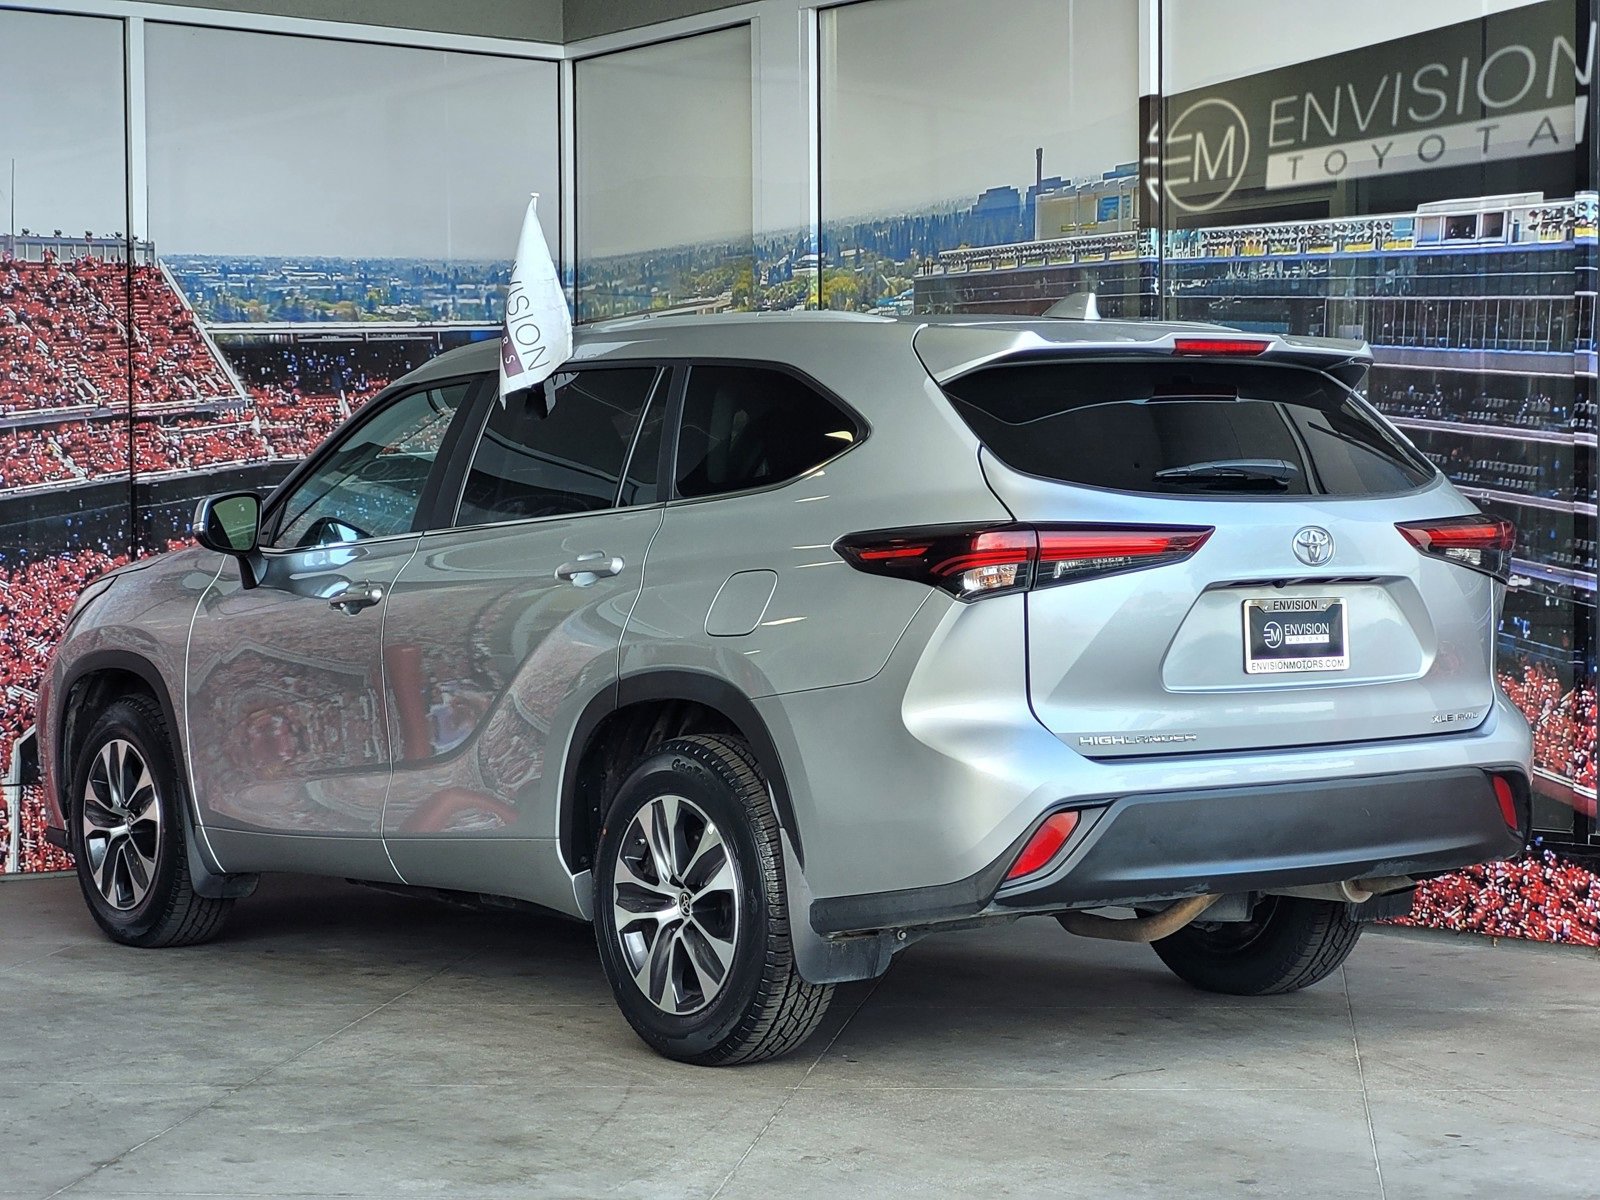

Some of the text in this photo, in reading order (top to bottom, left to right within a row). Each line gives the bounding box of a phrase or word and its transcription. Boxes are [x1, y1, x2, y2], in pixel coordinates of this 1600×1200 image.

[1268, 21, 1597, 147] ENVISION
[1287, 116, 1559, 180] TOYOTA
[1273, 600, 1318, 611] ENVISION
[1284, 622, 1330, 635] ENVISION
[1251, 659, 1345, 671] ENVISIONMOTORS.COM
[1432, 714, 1454, 724] XLE
[1079, 734, 1197, 746] HIGHLANDER
